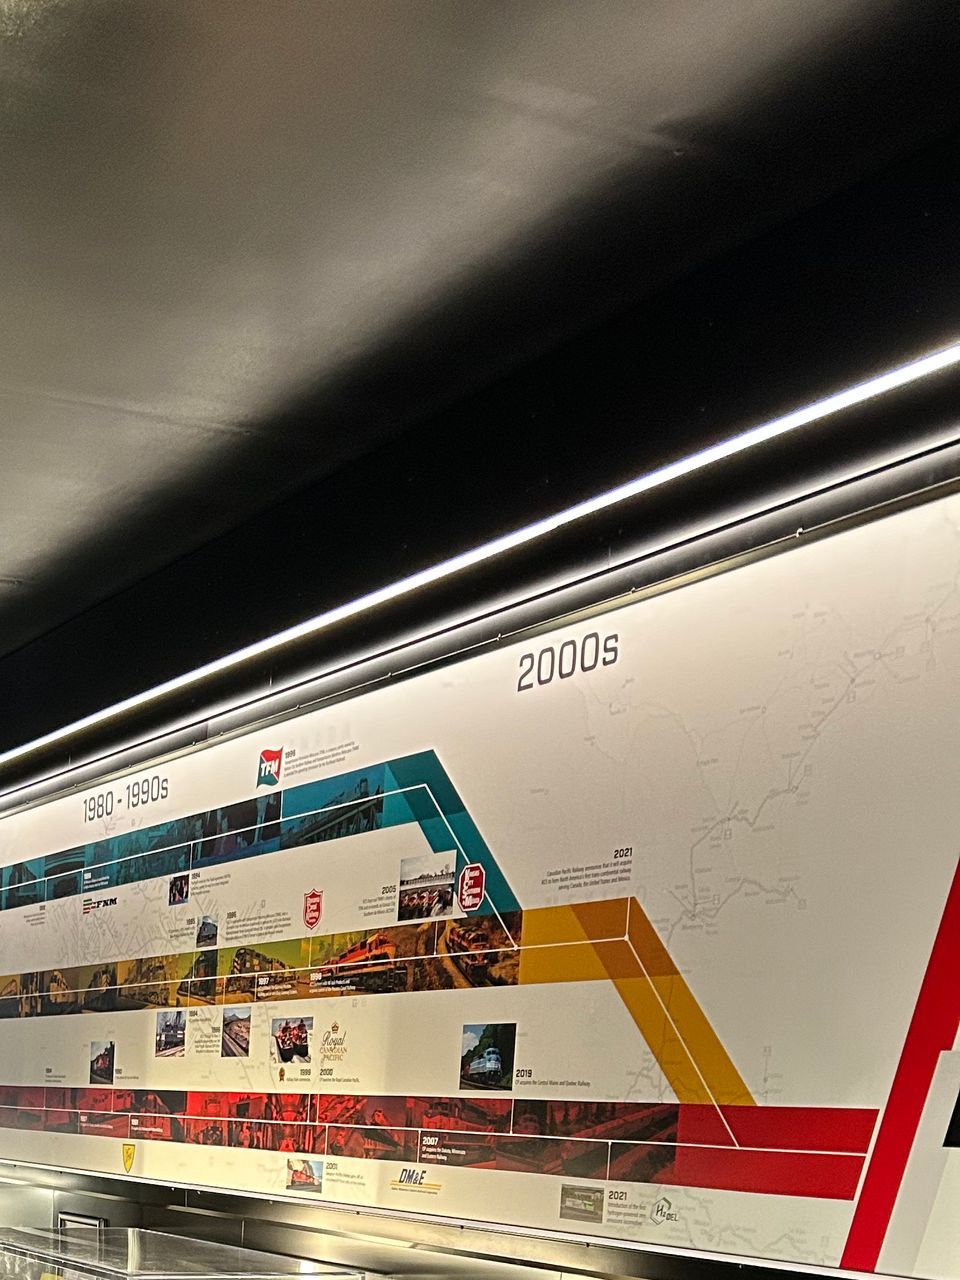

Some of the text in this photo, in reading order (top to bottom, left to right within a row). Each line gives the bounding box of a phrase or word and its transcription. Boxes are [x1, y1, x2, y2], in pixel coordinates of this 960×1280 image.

[517, 632, 619, 692] 2000s
[260, 758, 279, 777] TFM
[83, 791, 114, 823] 1980
[126, 775, 169, 810] 1990s
[613, 847, 633, 859] 2021
[381, 884, 397, 895] 2005
[96, 897, 117, 908] FNM
[321, 1031, 347, 1052] Royal
[320, 1068, 333, 1076] 2000
[515, 1069, 532, 1078] 2019
[422, 1136, 439, 1146] 2007
[398, 1168, 426, 1185] DM&E
[608, 1190, 627, 1201] 2021
